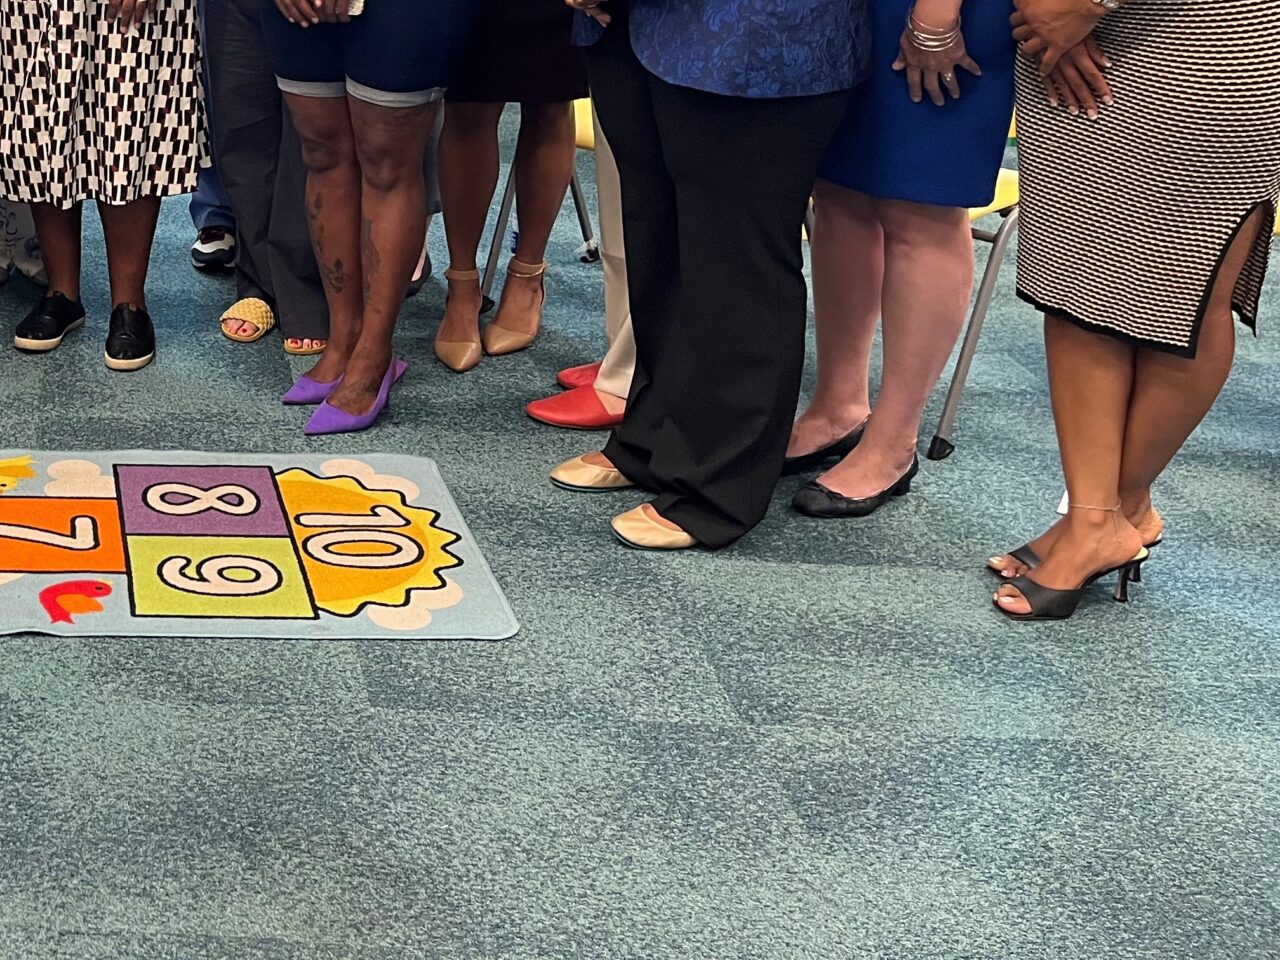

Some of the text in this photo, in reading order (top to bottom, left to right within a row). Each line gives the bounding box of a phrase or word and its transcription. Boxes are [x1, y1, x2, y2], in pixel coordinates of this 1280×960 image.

[141, 480, 262, 518] 8
[293, 503, 426, 569] 10
[154, 552, 284, 597] 9
